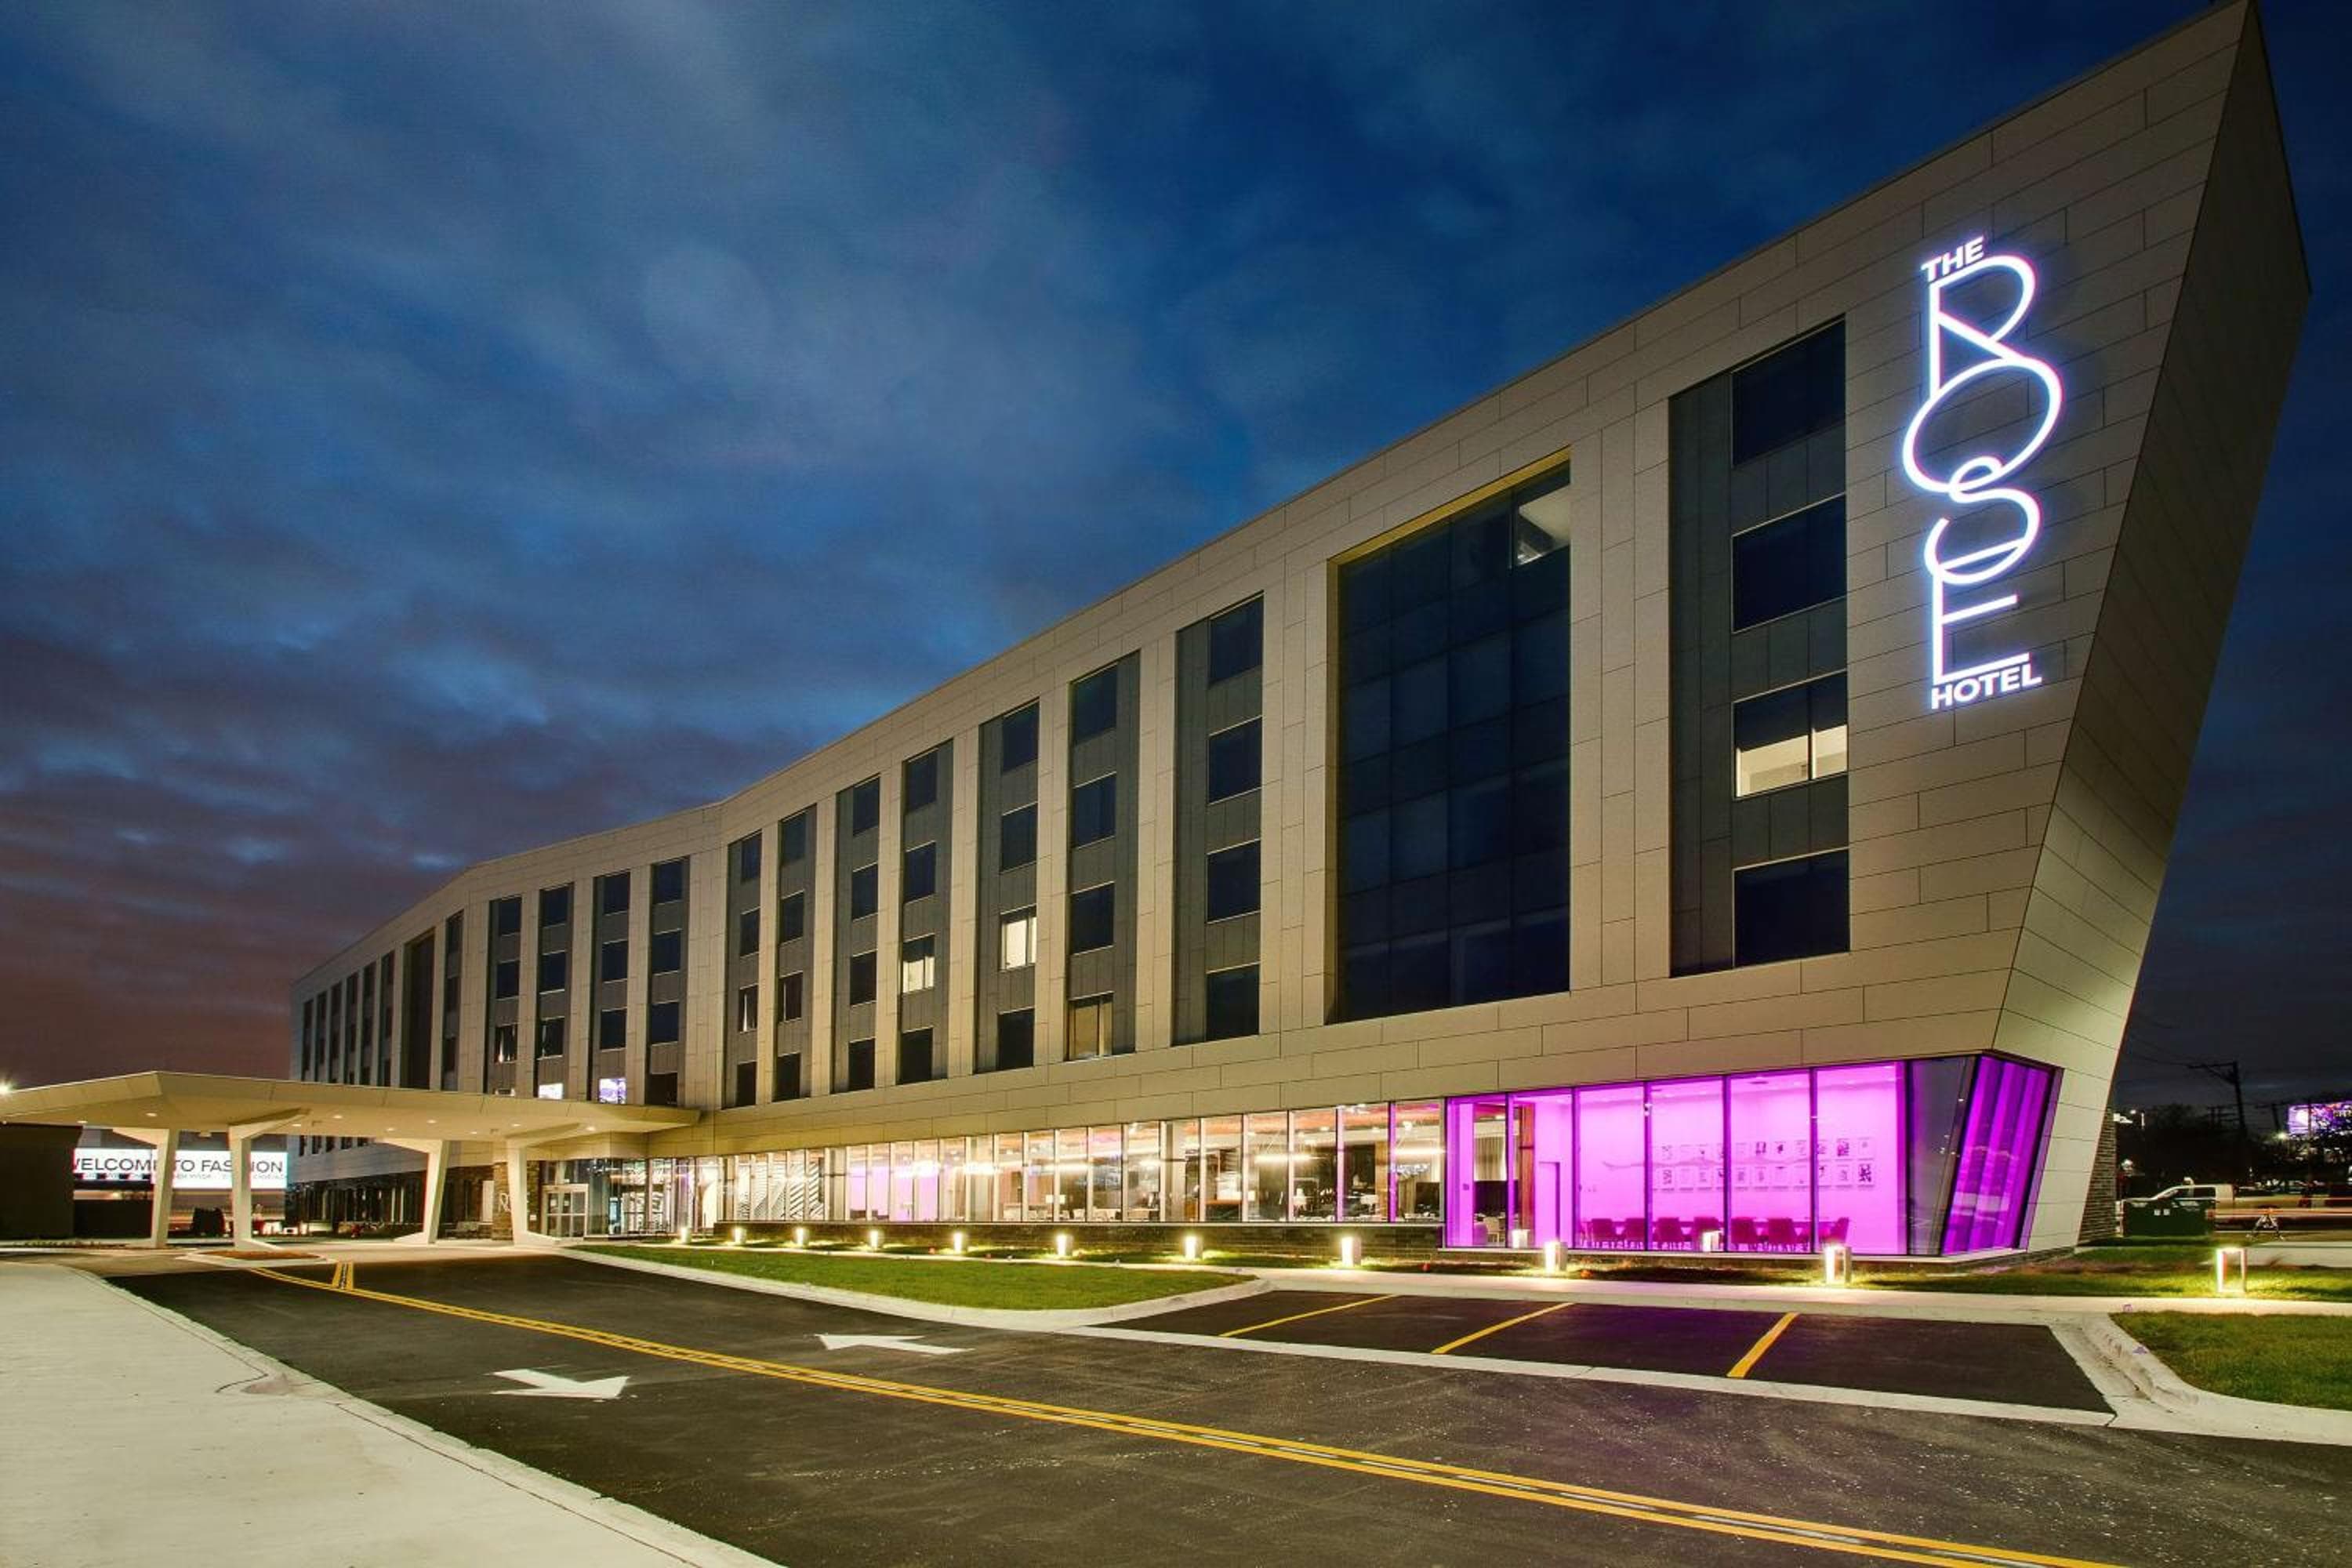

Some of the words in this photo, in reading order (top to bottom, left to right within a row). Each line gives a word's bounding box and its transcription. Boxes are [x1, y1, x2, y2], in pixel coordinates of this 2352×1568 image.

[1921, 236, 1984, 282] THE
[1902, 254, 2062, 685] ROSE
[1931, 663, 2043, 710] HOTEL
[74, 1157, 157, 1171] ELCOM
[201, 1160, 283, 1174] FASION
